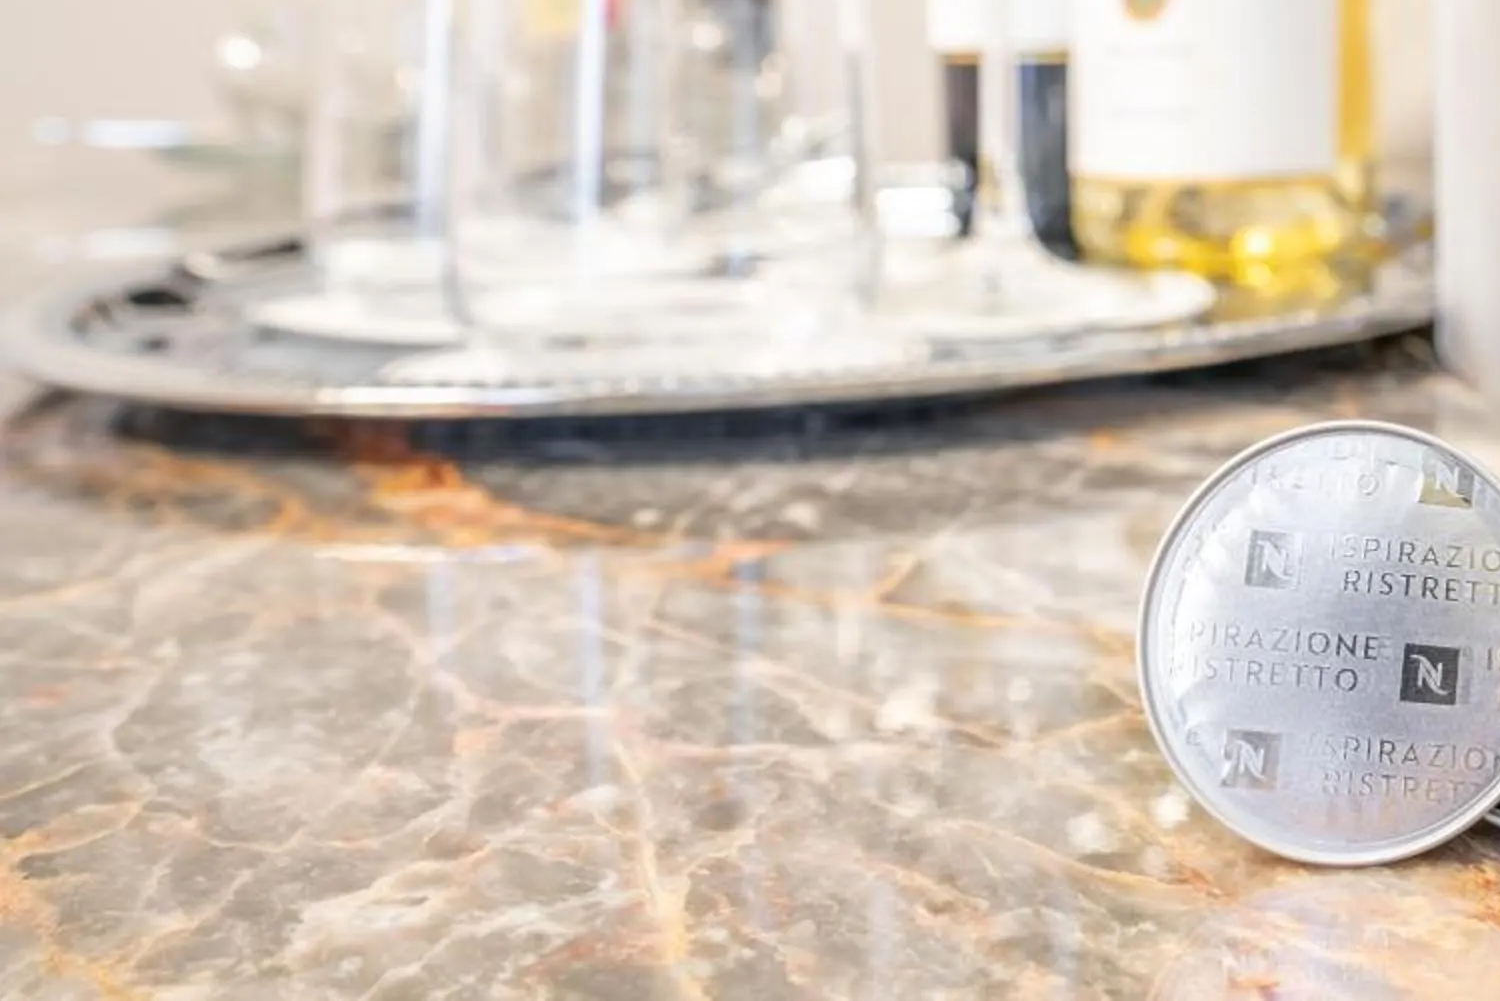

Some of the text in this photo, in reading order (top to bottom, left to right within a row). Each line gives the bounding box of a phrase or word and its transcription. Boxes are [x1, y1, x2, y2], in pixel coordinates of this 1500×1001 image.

[1189, 620, 1380, 661] PIRAZIONE
[1169, 652, 1359, 692] ISTRETTO
[1322, 769, 1483, 805] RISTRET
